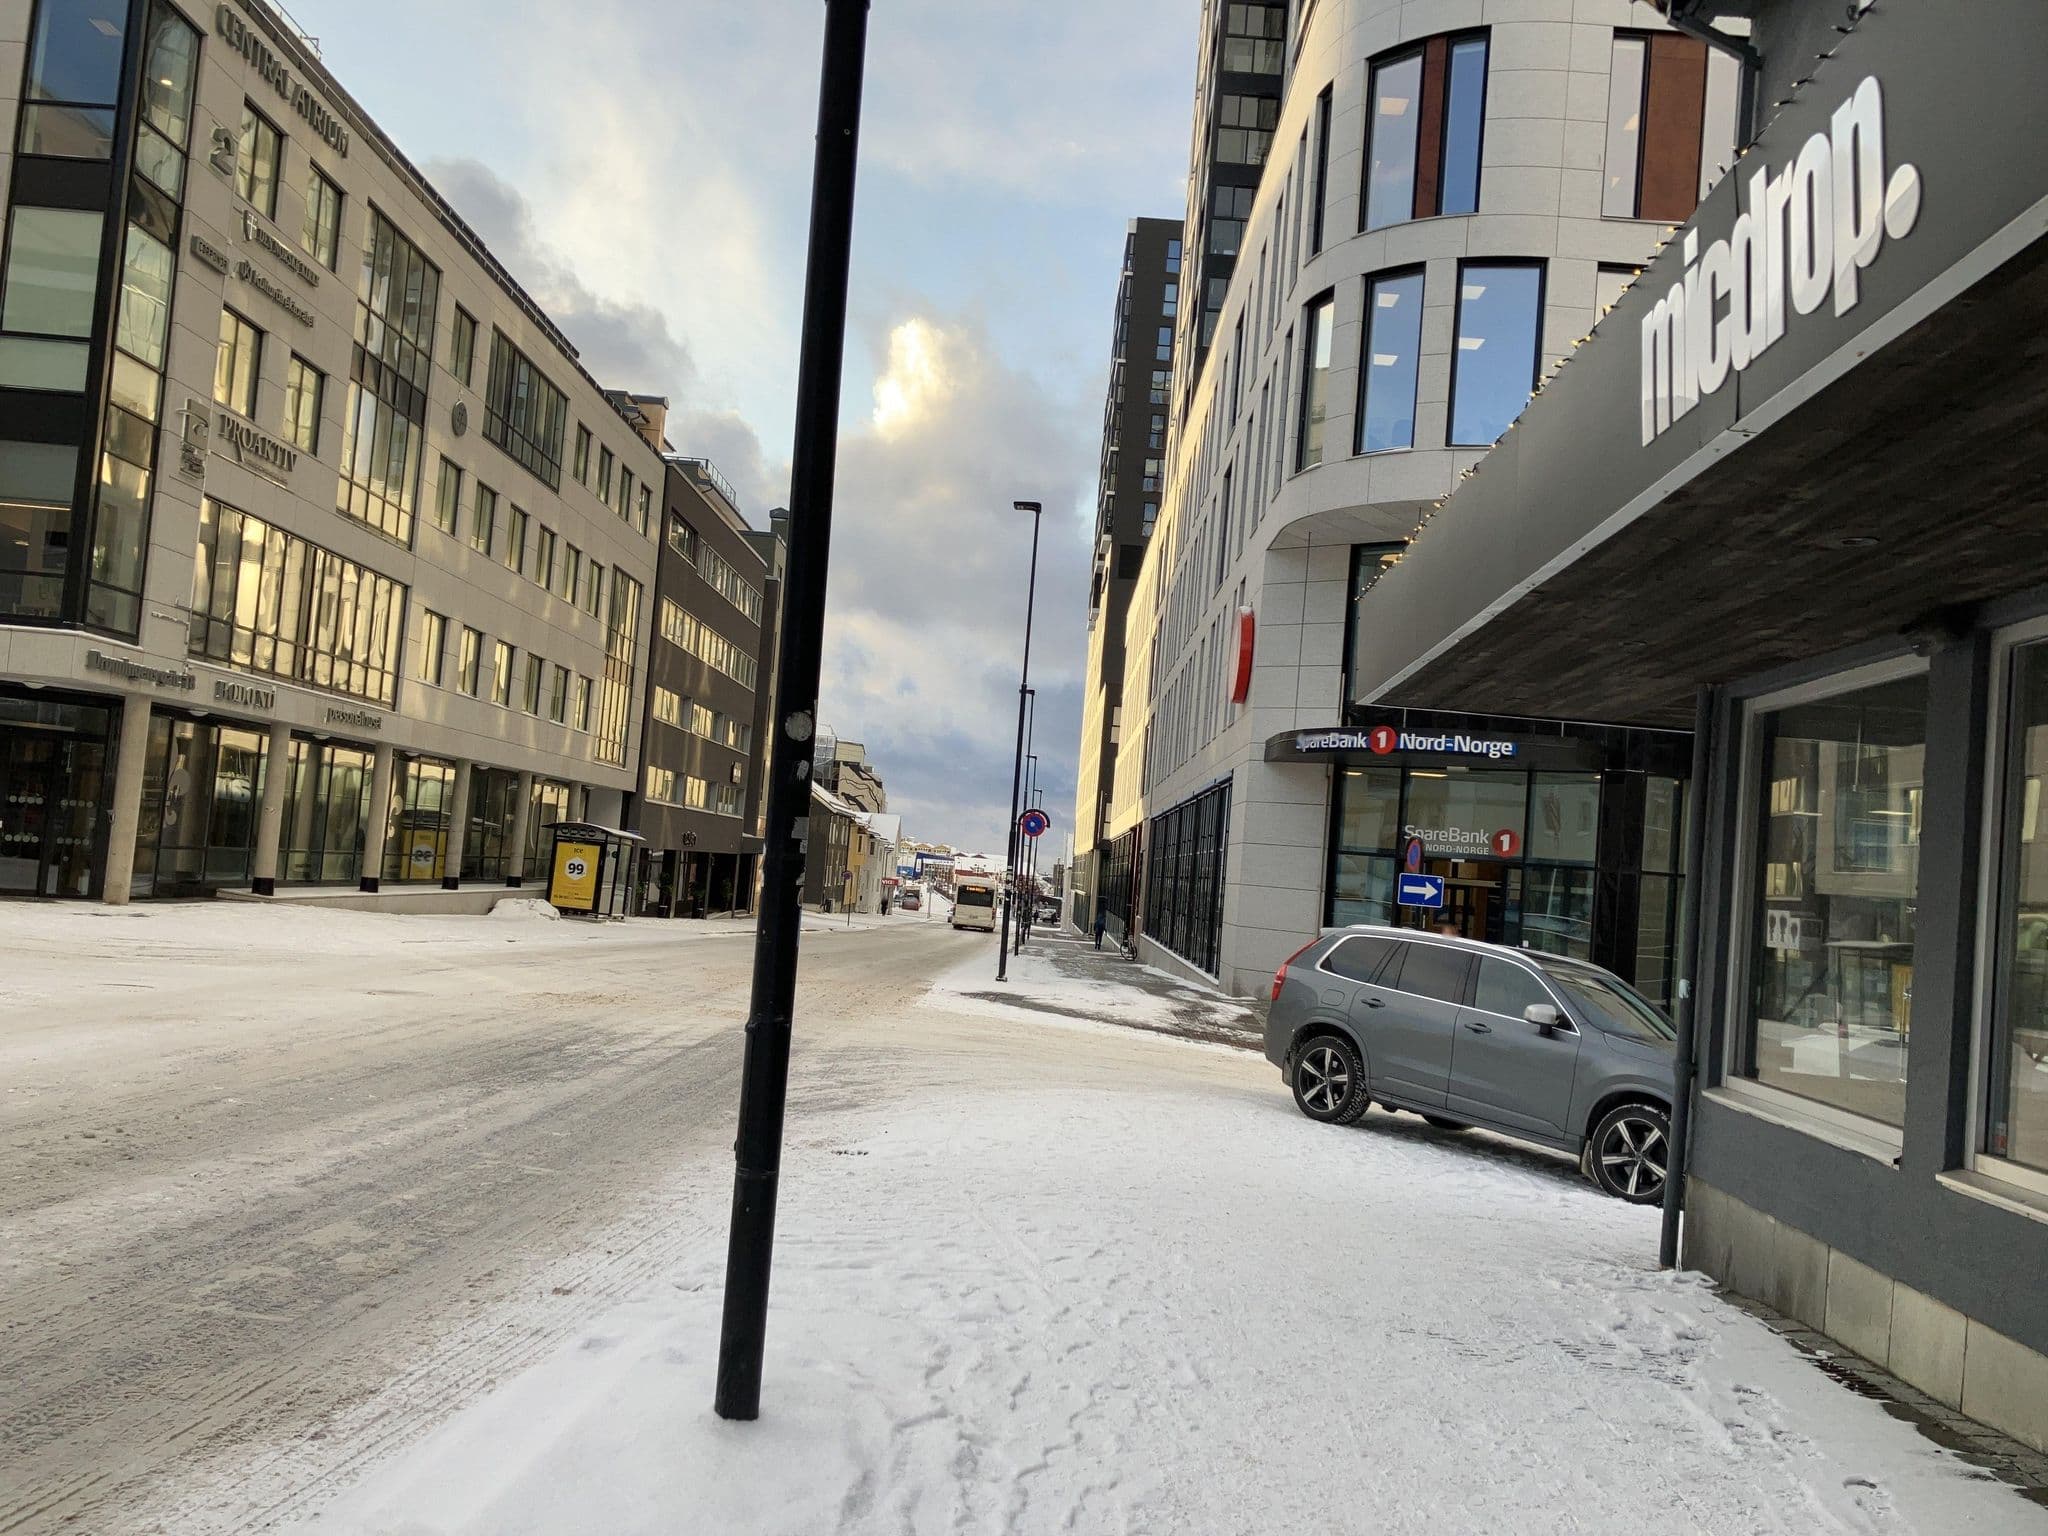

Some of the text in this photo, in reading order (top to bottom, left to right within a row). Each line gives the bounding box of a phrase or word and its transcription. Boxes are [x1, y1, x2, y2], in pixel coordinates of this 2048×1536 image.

[215, 4, 350, 158] CENTRAL ATRIUM
[1642, 75, 1921, 447] micdrop.
[218, 414, 298, 472] PROAKTIV
[1376, 731, 1388, 749] 1
[1400, 733, 1514, 759] Nord-Norge
[1425, 843, 1489, 855] NORD-NORGE
[1499, 833, 1511, 852] 1
[568, 862, 585, 875] 99
